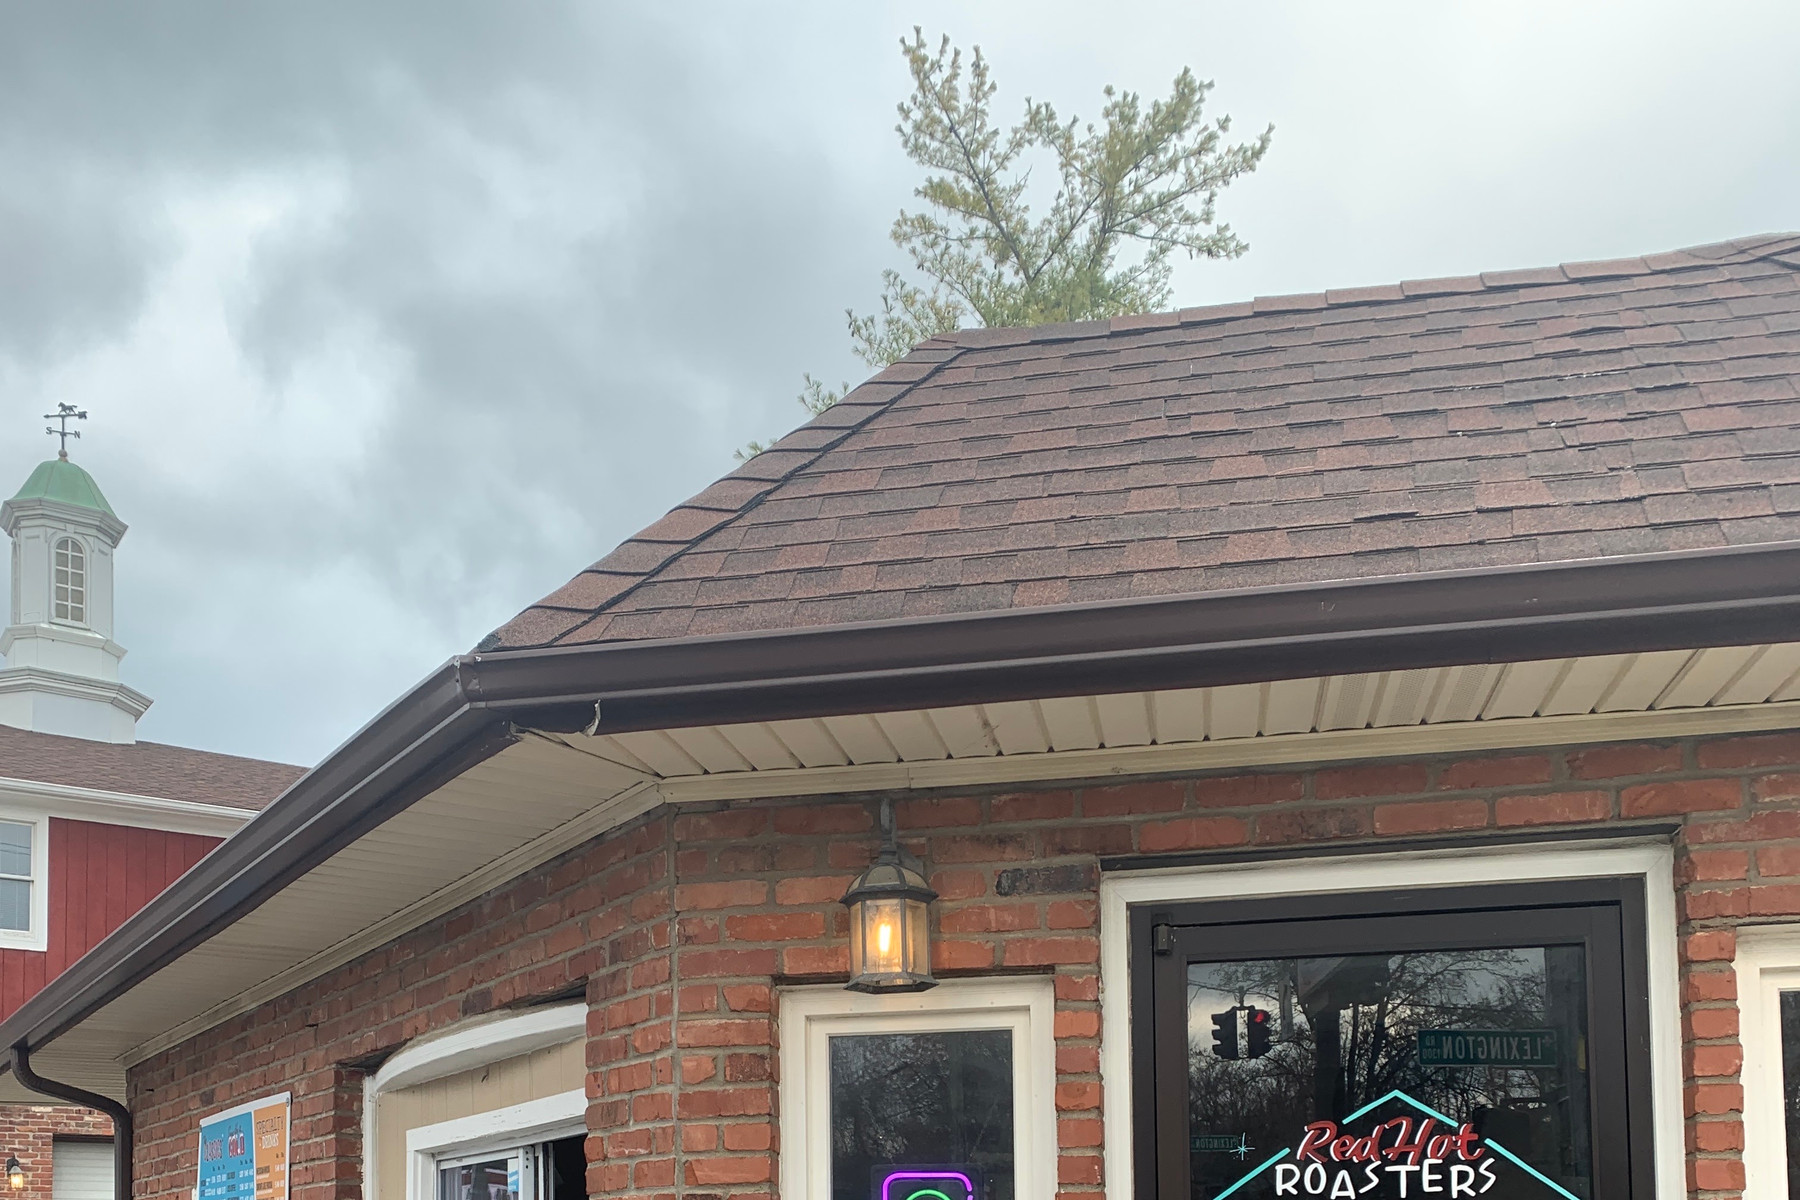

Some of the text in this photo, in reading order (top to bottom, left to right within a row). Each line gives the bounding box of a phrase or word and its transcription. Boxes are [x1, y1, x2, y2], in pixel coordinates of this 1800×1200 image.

[1296, 1116, 1485, 1166] Red Hot
[1275, 1158, 1497, 1200] ROASTERS
